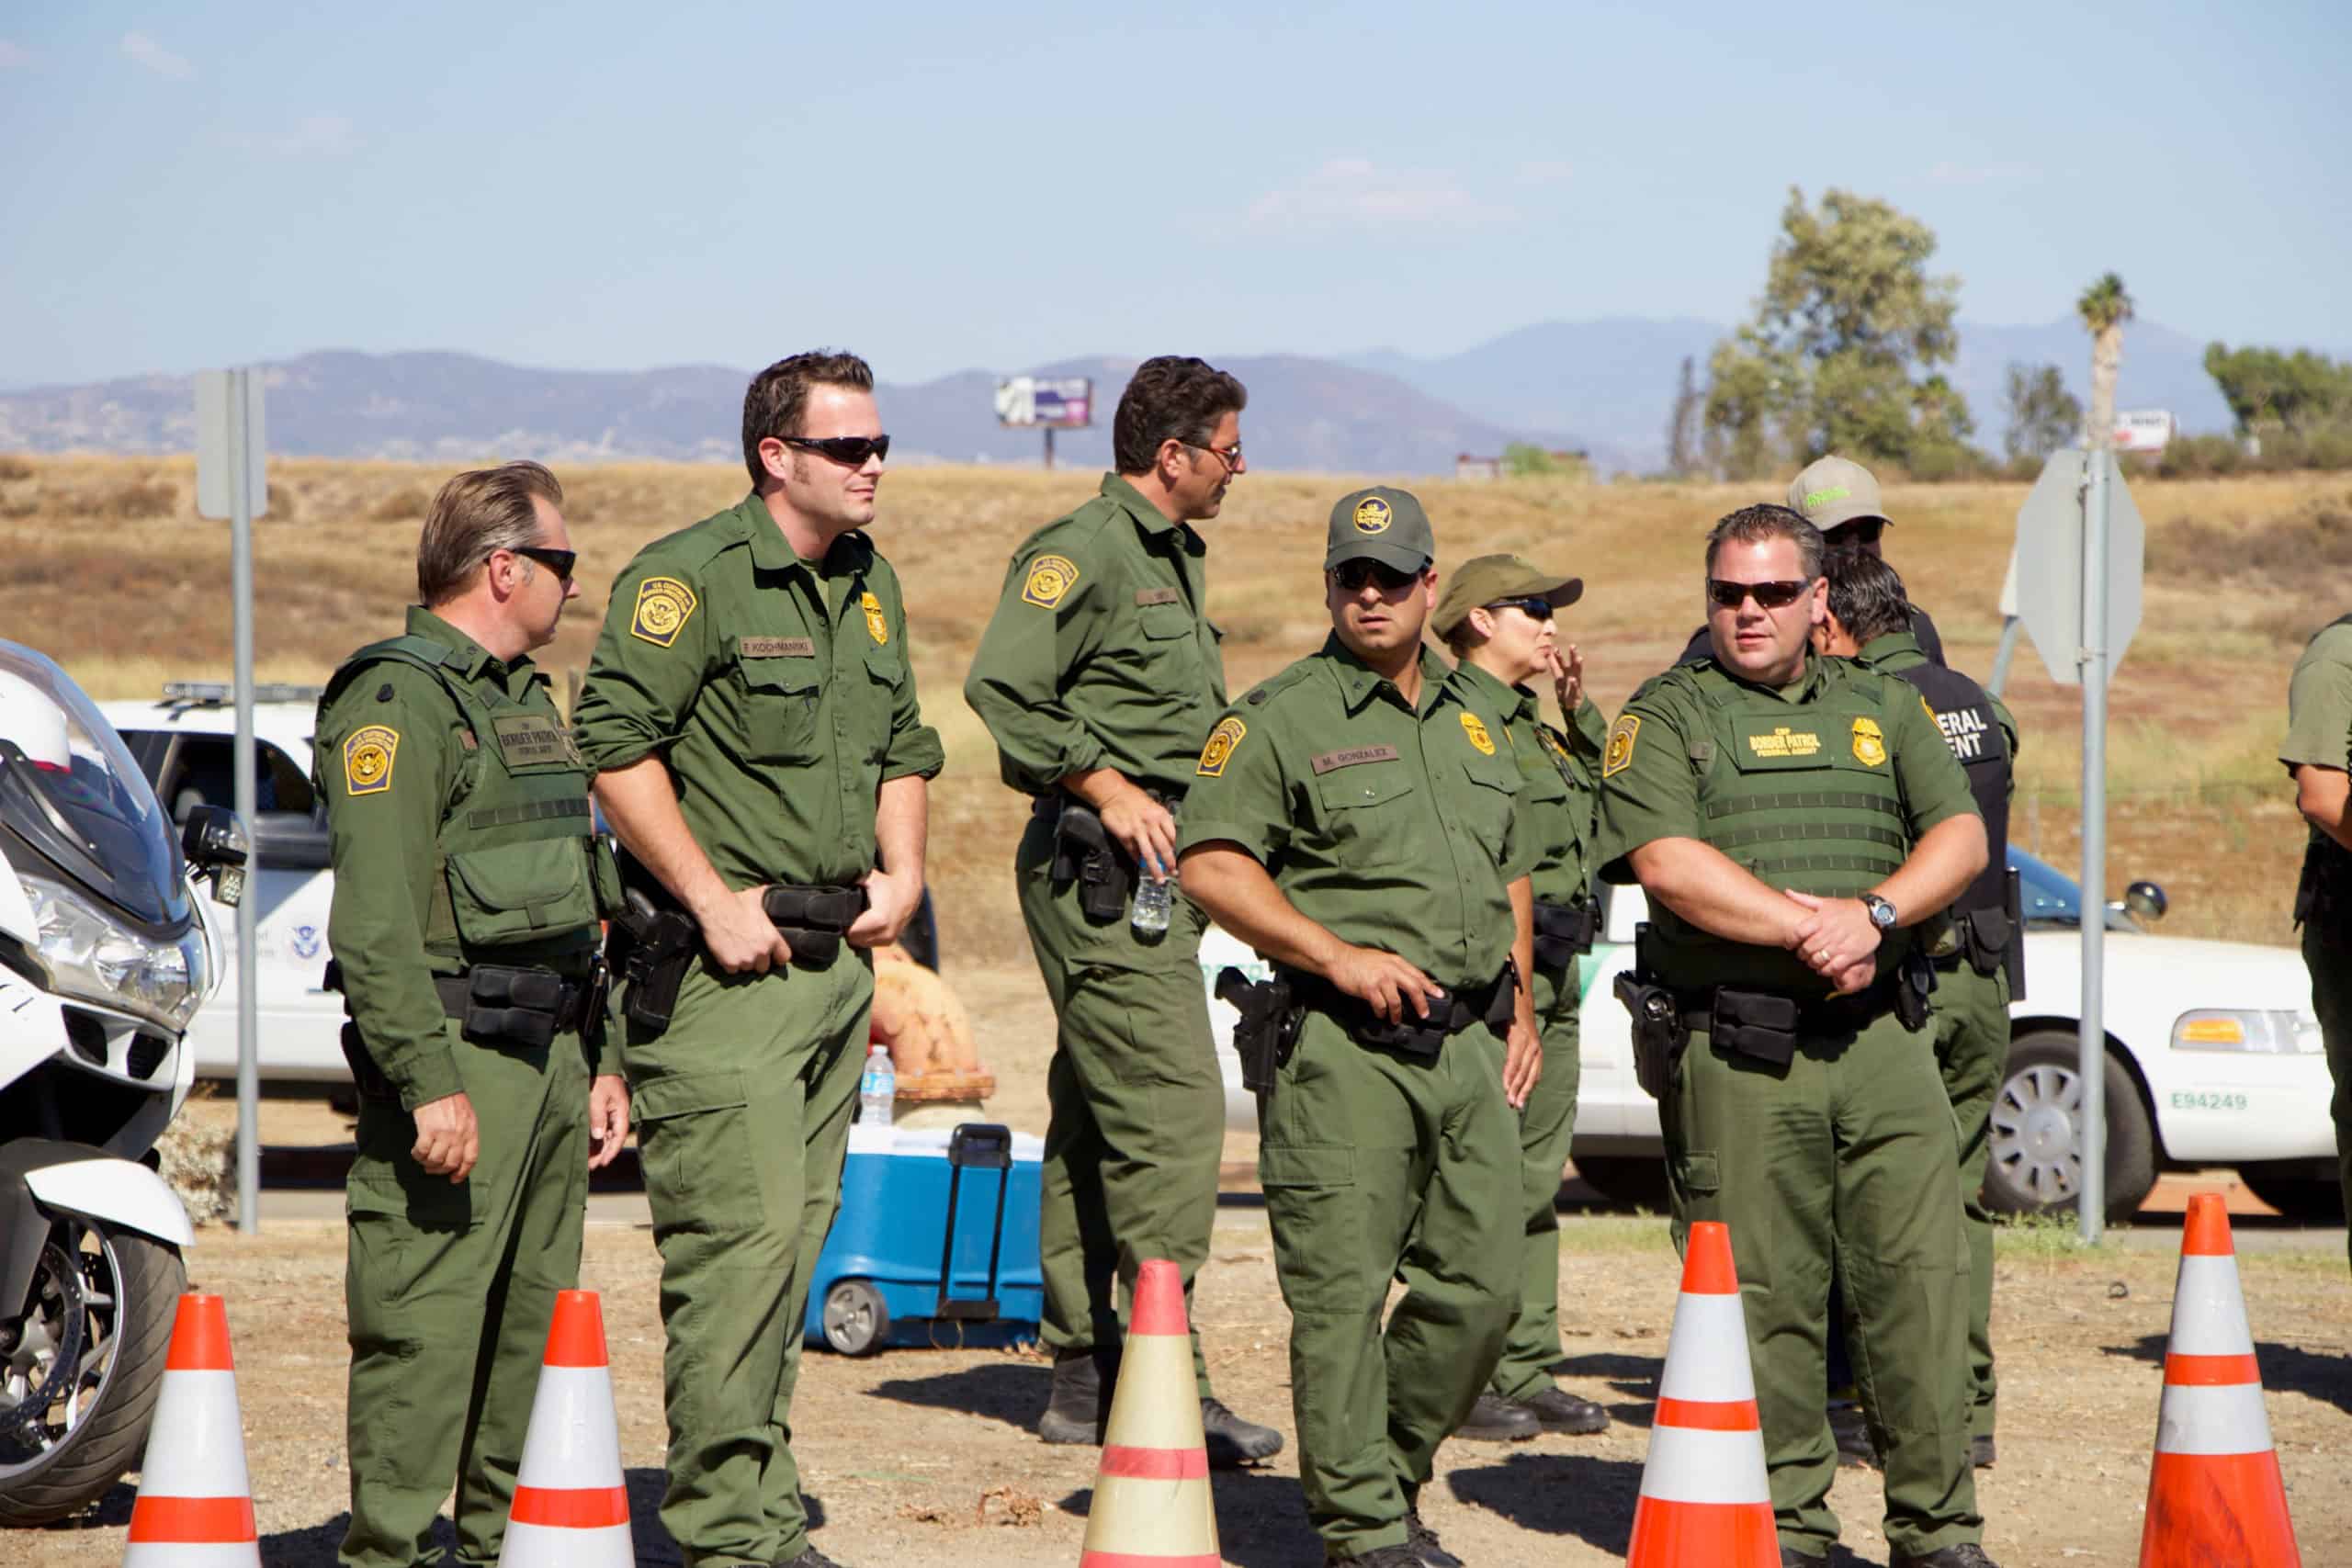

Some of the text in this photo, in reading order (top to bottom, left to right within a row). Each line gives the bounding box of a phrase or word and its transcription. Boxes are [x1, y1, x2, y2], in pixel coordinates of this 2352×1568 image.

[500, 729, 559, 747] BORDER PATROL
[1748, 733, 1821, 750] BORDER PATROL
[1337, 748, 1388, 761] GONZALEZ
[2171, 1092, 2248, 1111] E94249
